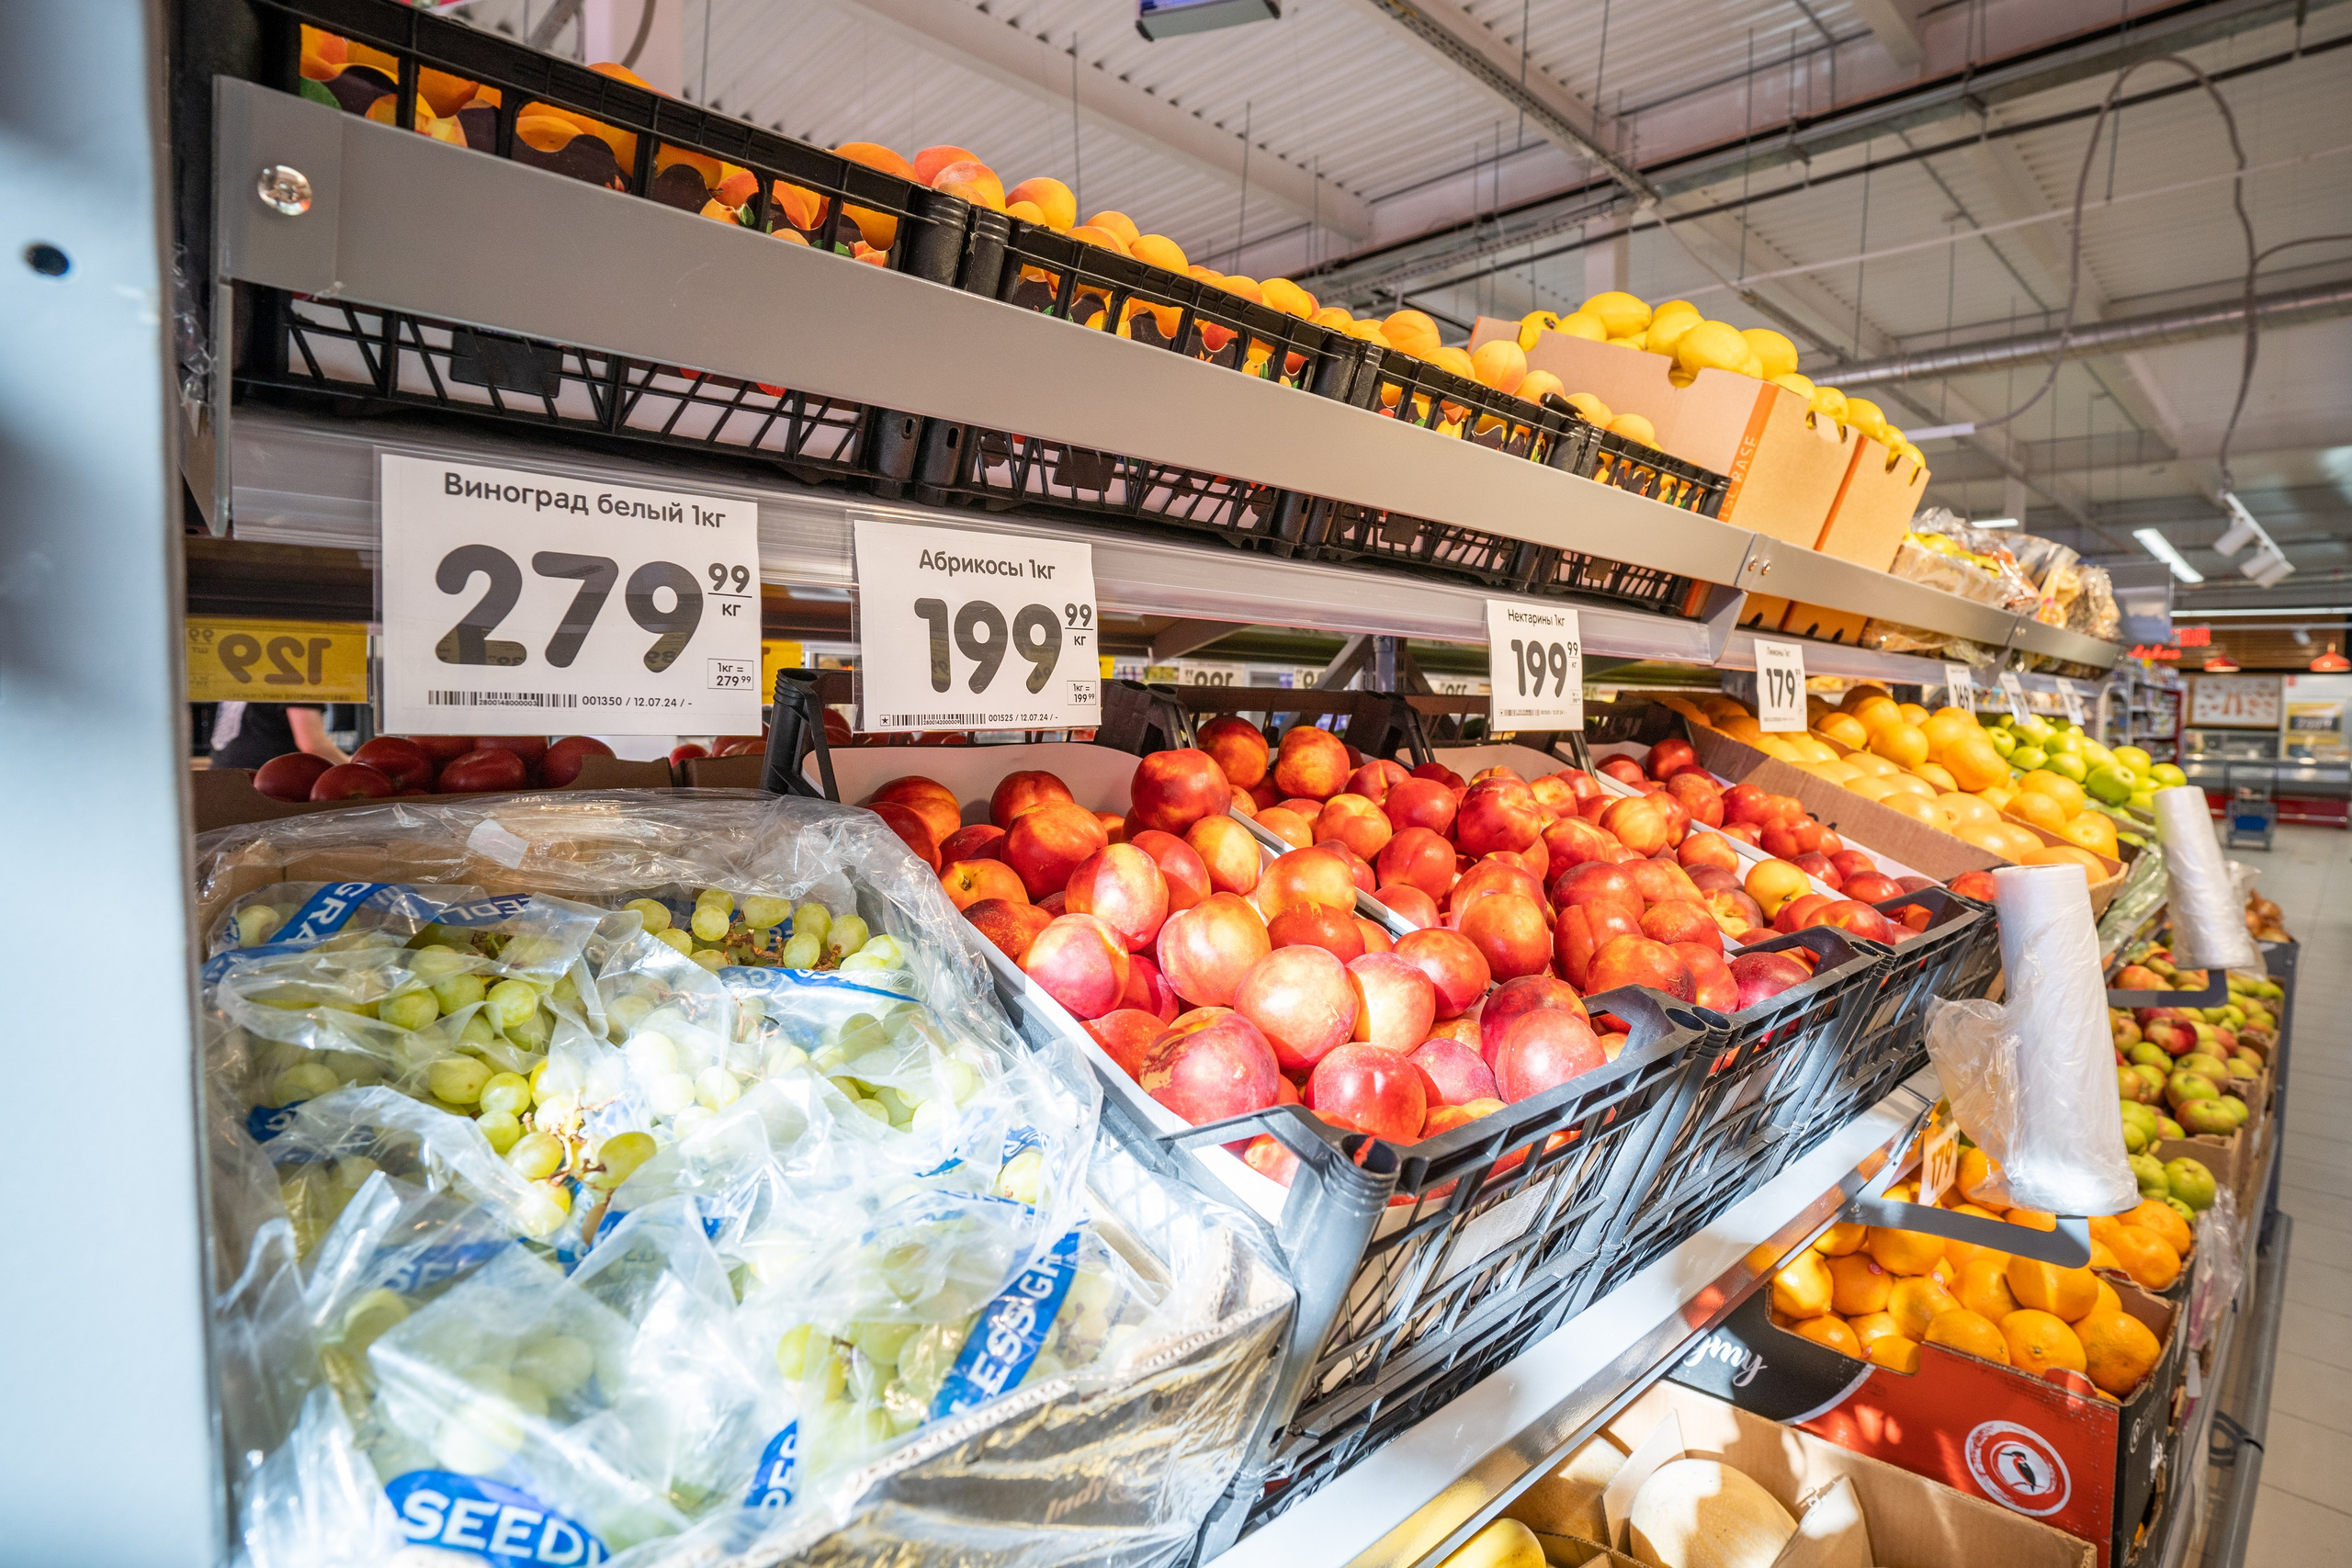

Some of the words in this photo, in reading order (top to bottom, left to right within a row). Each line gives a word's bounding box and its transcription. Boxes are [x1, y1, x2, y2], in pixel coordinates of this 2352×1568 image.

[1731, 435, 1758, 483] BASE
[444, 471, 589, 515] Виноград
[596, 492, 684, 524] белый
[691, 504, 727, 528] 1кг
[919, 549, 1024, 577] Абрикосы
[1028, 558, 1056, 580] 1кг
[435, 544, 704, 673] 279
[708, 562, 750, 593] 99
[722, 604, 741, 616] кг
[1508, 608, 1554, 626] Нектарины
[1555, 614, 1566, 626] 1кг
[914, 597, 1063, 694] 199
[1065, 603, 1092, 627] 99
[1074, 636, 1087, 646] кг
[718, 662, 733, 672] 1кг
[1510, 639, 1567, 698] 199
[1567, 641, 1578, 656] 99
[717, 675, 740, 687] 279
[1073, 683, 1083, 692] 1кг
[1766, 668, 1795, 709] 179
[582, 695, 623, 706] 001350
[634, 696, 678, 707] 12.07.24
[1074, 694, 1088, 703] 199
[989, 714, 1013, 722] 001525
[1021, 713, 1048, 721] 12.07.24
[1931, 1138, 1953, 1190] 179
